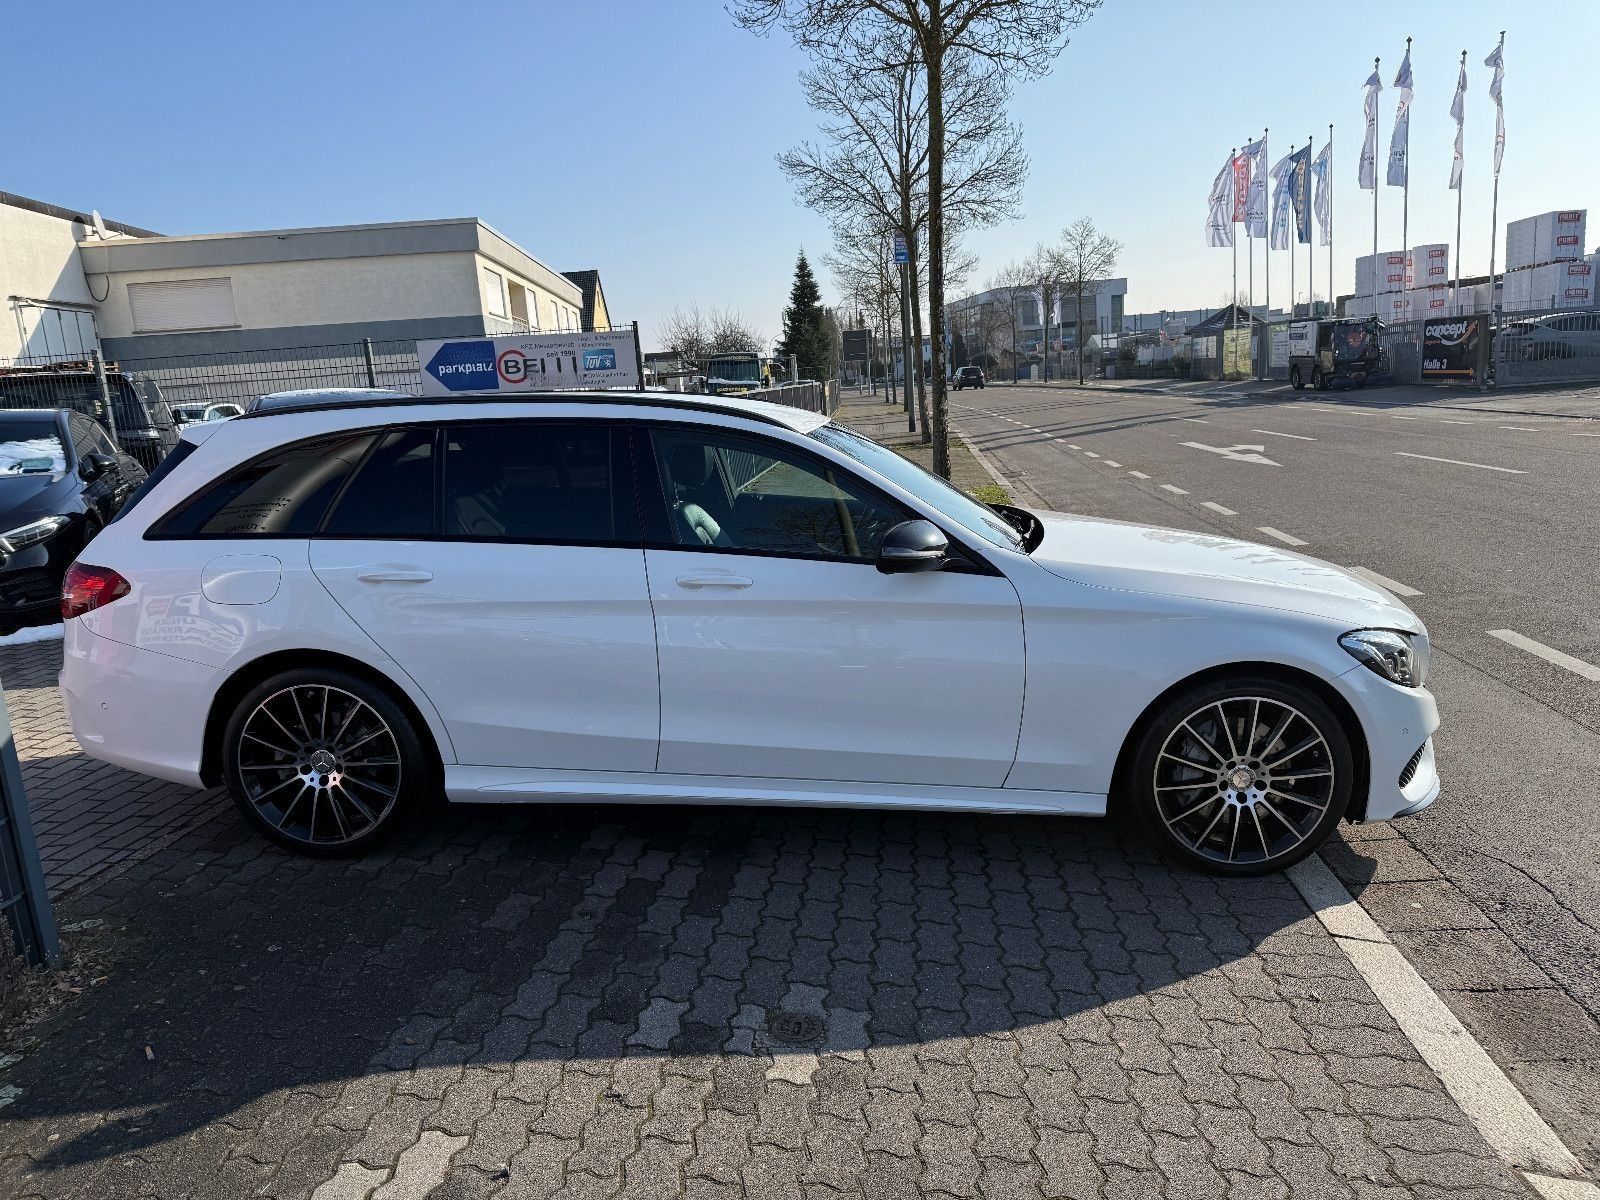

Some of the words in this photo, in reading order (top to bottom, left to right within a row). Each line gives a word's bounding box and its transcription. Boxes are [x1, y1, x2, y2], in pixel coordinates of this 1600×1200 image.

[1425, 321, 1468, 338] concept
[1423, 358, 1440, 370] Halle
[1441, 358, 1448, 370] 3
